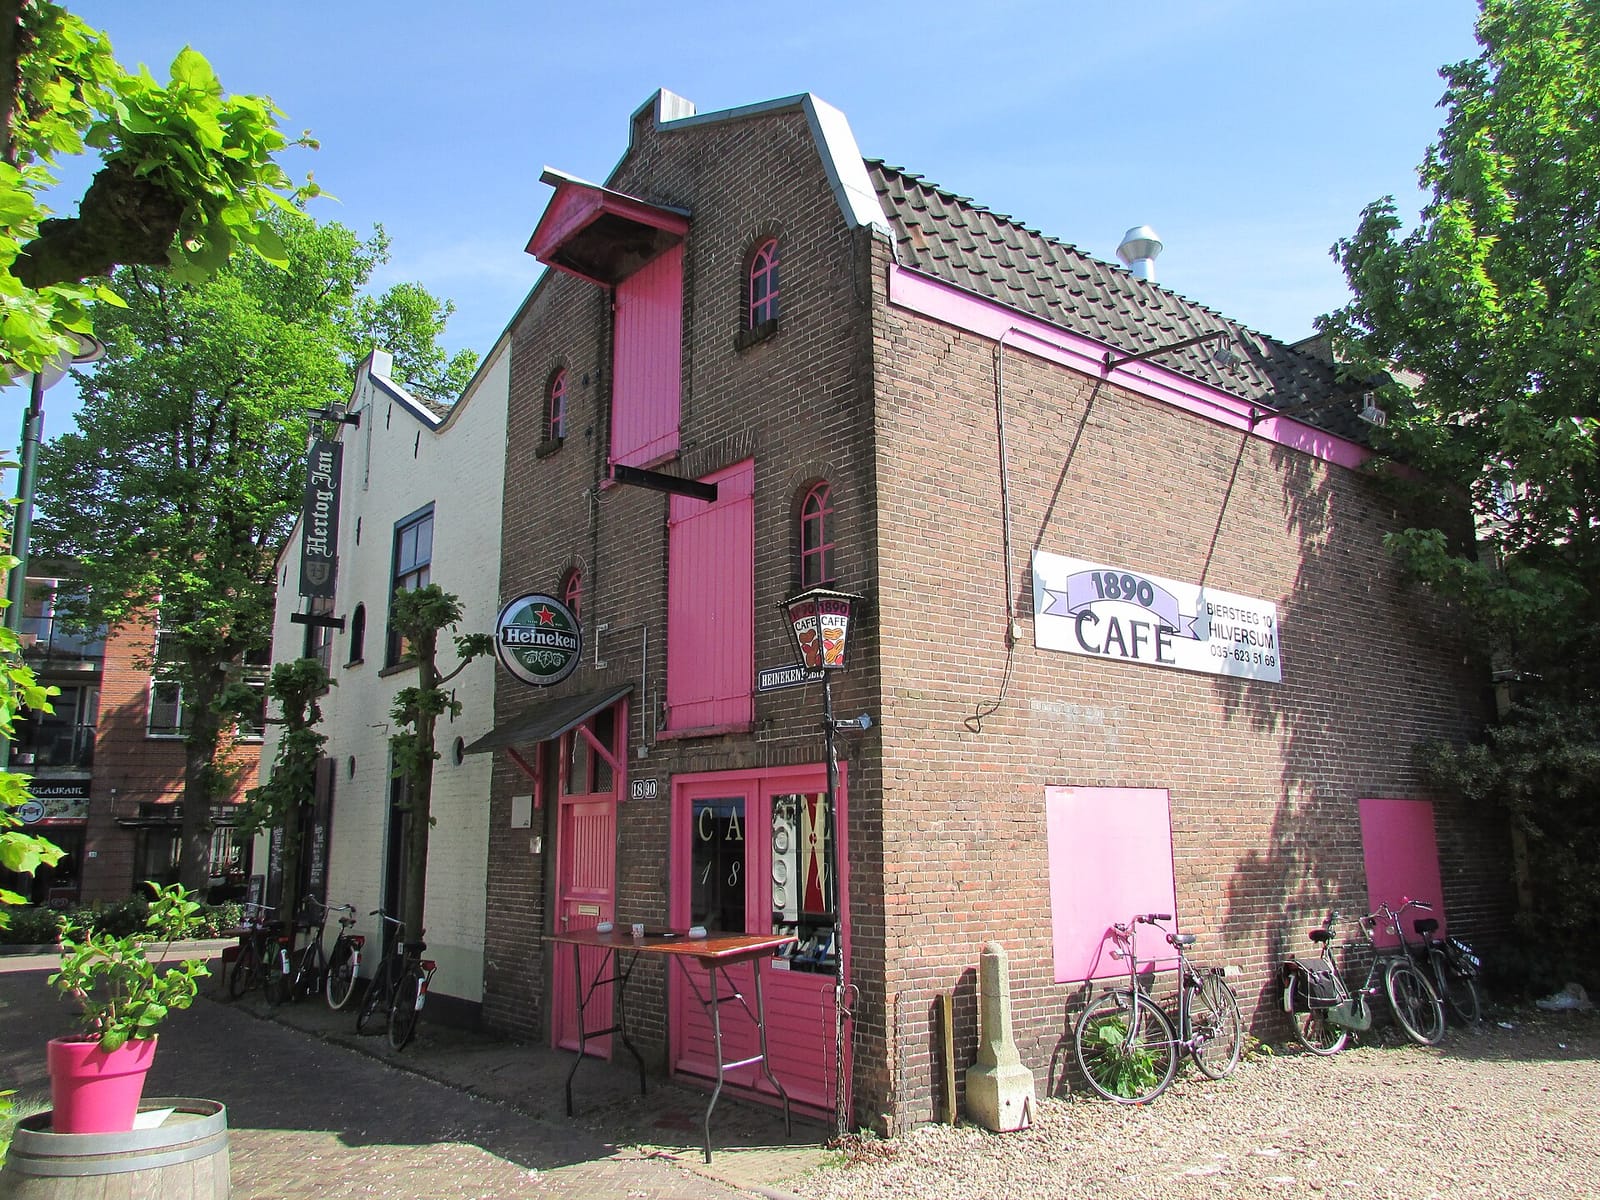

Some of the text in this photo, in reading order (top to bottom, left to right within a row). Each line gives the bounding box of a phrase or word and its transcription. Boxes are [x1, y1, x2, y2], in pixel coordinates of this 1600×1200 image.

[306, 450, 337, 558] Hertog Jan
[1090, 571, 1154, 607] 1890
[819, 601, 848, 614] 1890
[1206, 602, 1273, 629] BIERSTEEG 10
[794, 616, 817, 631] CAFE
[820, 615, 846, 627] CAFE
[506, 628, 577, 649] Heineken
[1074, 608, 1176, 665] CAFE
[1208, 621, 1274, 649] HILVERSUM
[1252, 652, 1263, 665] 51
[1264, 654, 1276, 667] 69
[27, 786, 83, 795] STAURANT
